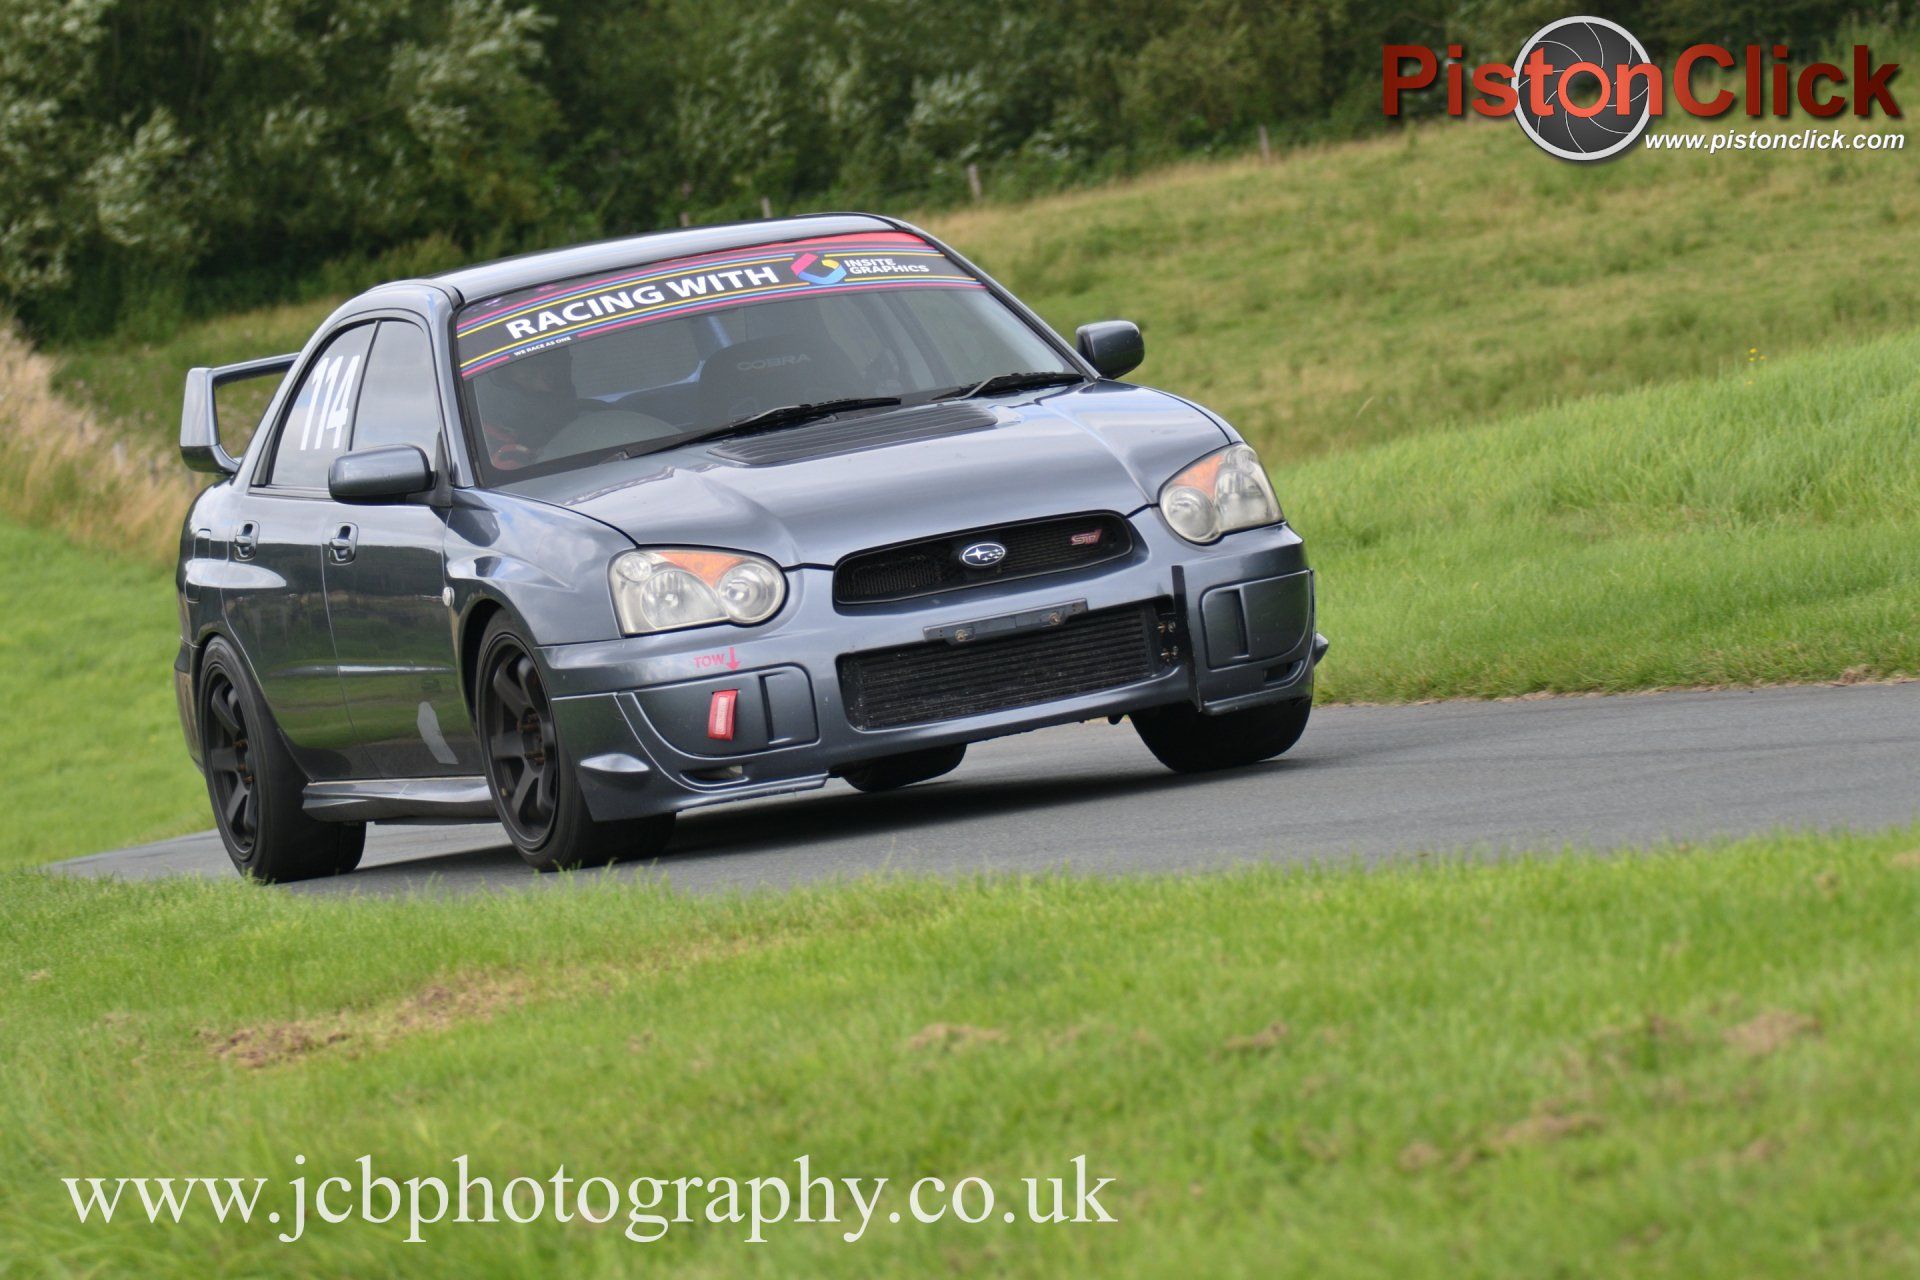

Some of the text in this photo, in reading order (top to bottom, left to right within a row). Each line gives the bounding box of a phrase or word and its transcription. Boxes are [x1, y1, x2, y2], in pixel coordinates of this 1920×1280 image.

[844, 258, 896, 268] INSITE
[849, 264, 930, 275] GRAPHICS
[505, 266, 780, 339] RACING WITH
[513, 349, 526, 357] WE
[526, 344, 545, 353] RACE
[545, 340, 556, 348] AS
[300, 355, 361, 451] 114
[694, 653, 726, 669] TOW
